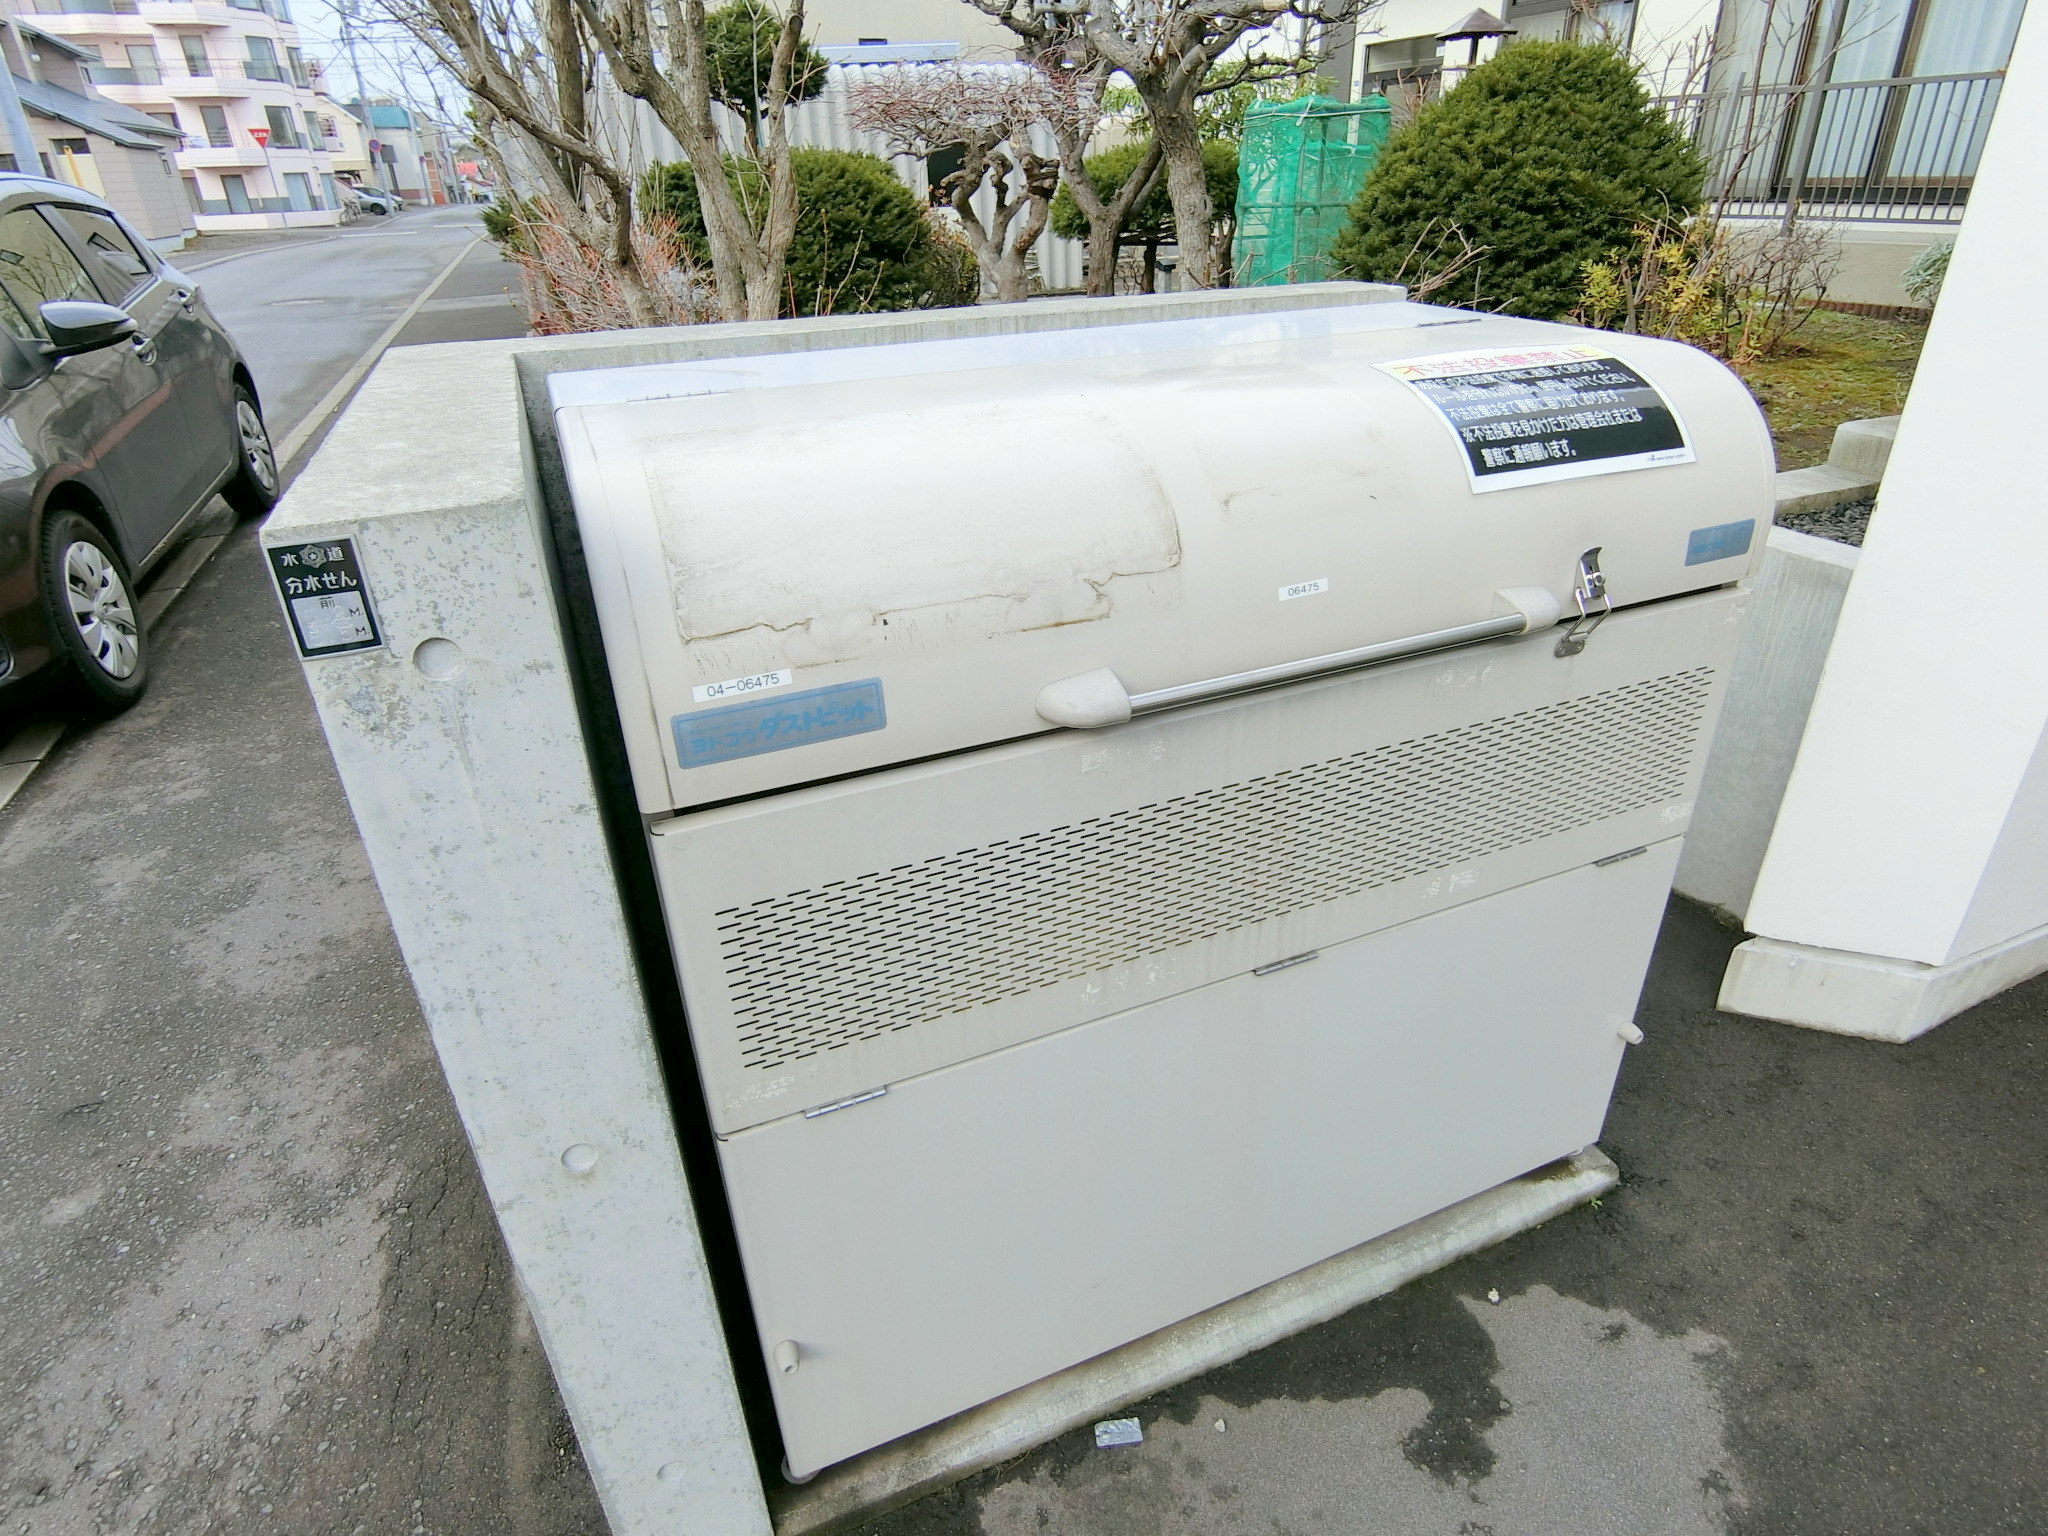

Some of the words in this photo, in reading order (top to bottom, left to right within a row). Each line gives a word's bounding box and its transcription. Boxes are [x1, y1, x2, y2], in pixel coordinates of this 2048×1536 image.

[1392, 348, 1600, 376] 不法投棄禁止
[1445, 389, 1626, 421] 不法投棄は全て警察に届け出ております。
[1480, 438, 1577, 468] 警察に通報願います。
[285, 570, 357, 595] 分水せん
[1287, 581, 1320, 597] 06475
[707, 672, 780, 697] 04-06475
